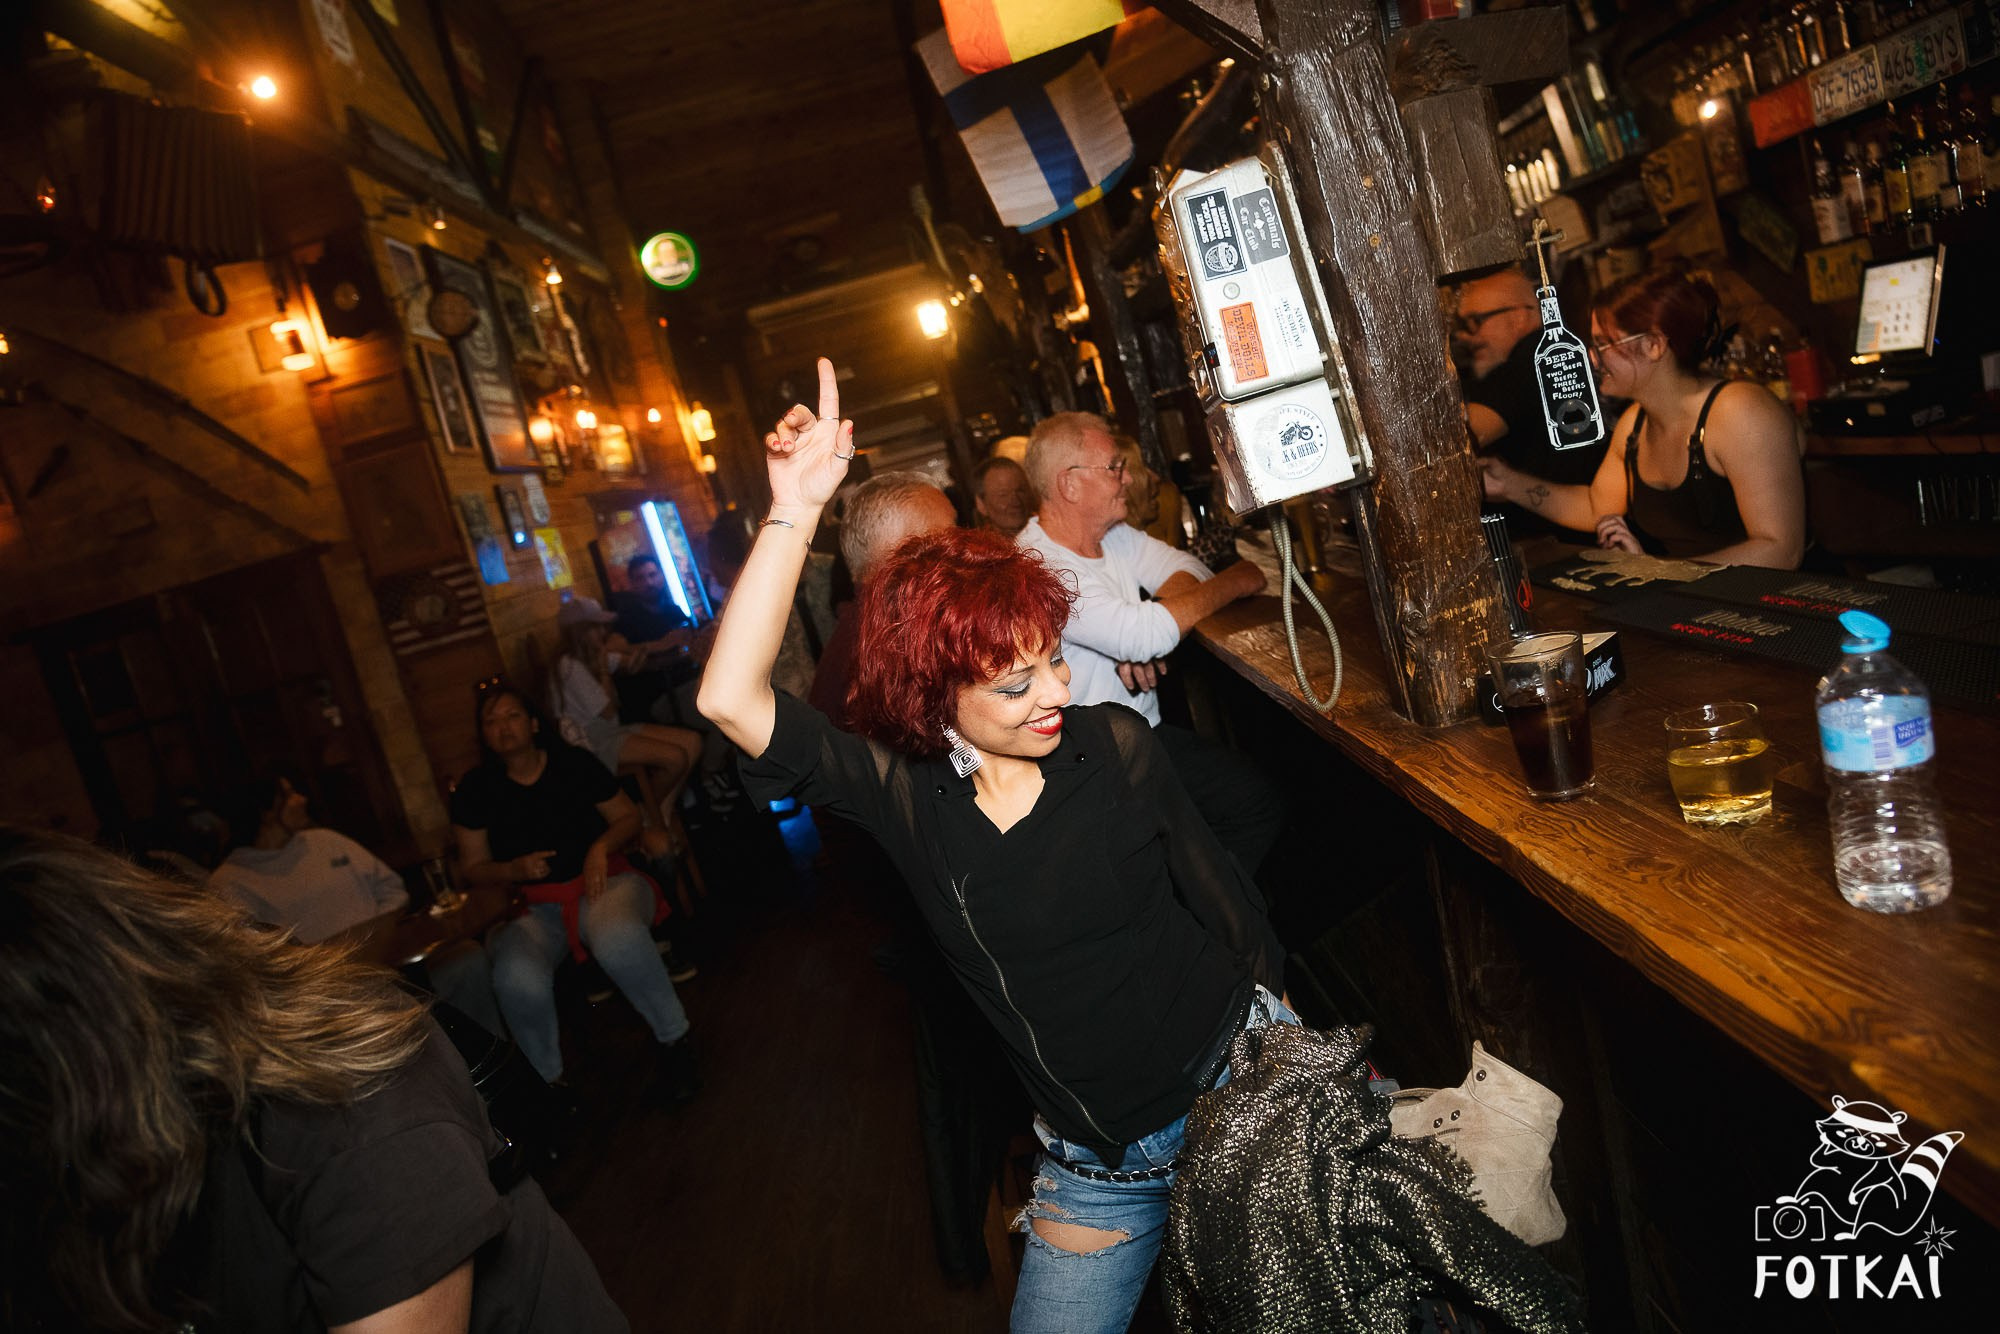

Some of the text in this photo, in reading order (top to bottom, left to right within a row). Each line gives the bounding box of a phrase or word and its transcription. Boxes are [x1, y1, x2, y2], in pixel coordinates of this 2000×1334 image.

[1239, 206, 1249, 226] Car
[1244, 228, 1260, 251] Club
[1258, 196, 1282, 250] Cardinals
[1287, 313, 1303, 350] TAURUS
[1232, 308, 1256, 377] DEVIL DOLLS
[1545, 352, 1575, 365] BEER
[1563, 362, 1582, 371] BEER
[1553, 379, 1576, 388] THREE
[1554, 372, 1577, 382] BEERS
[1562, 382, 1586, 392] BEERS
